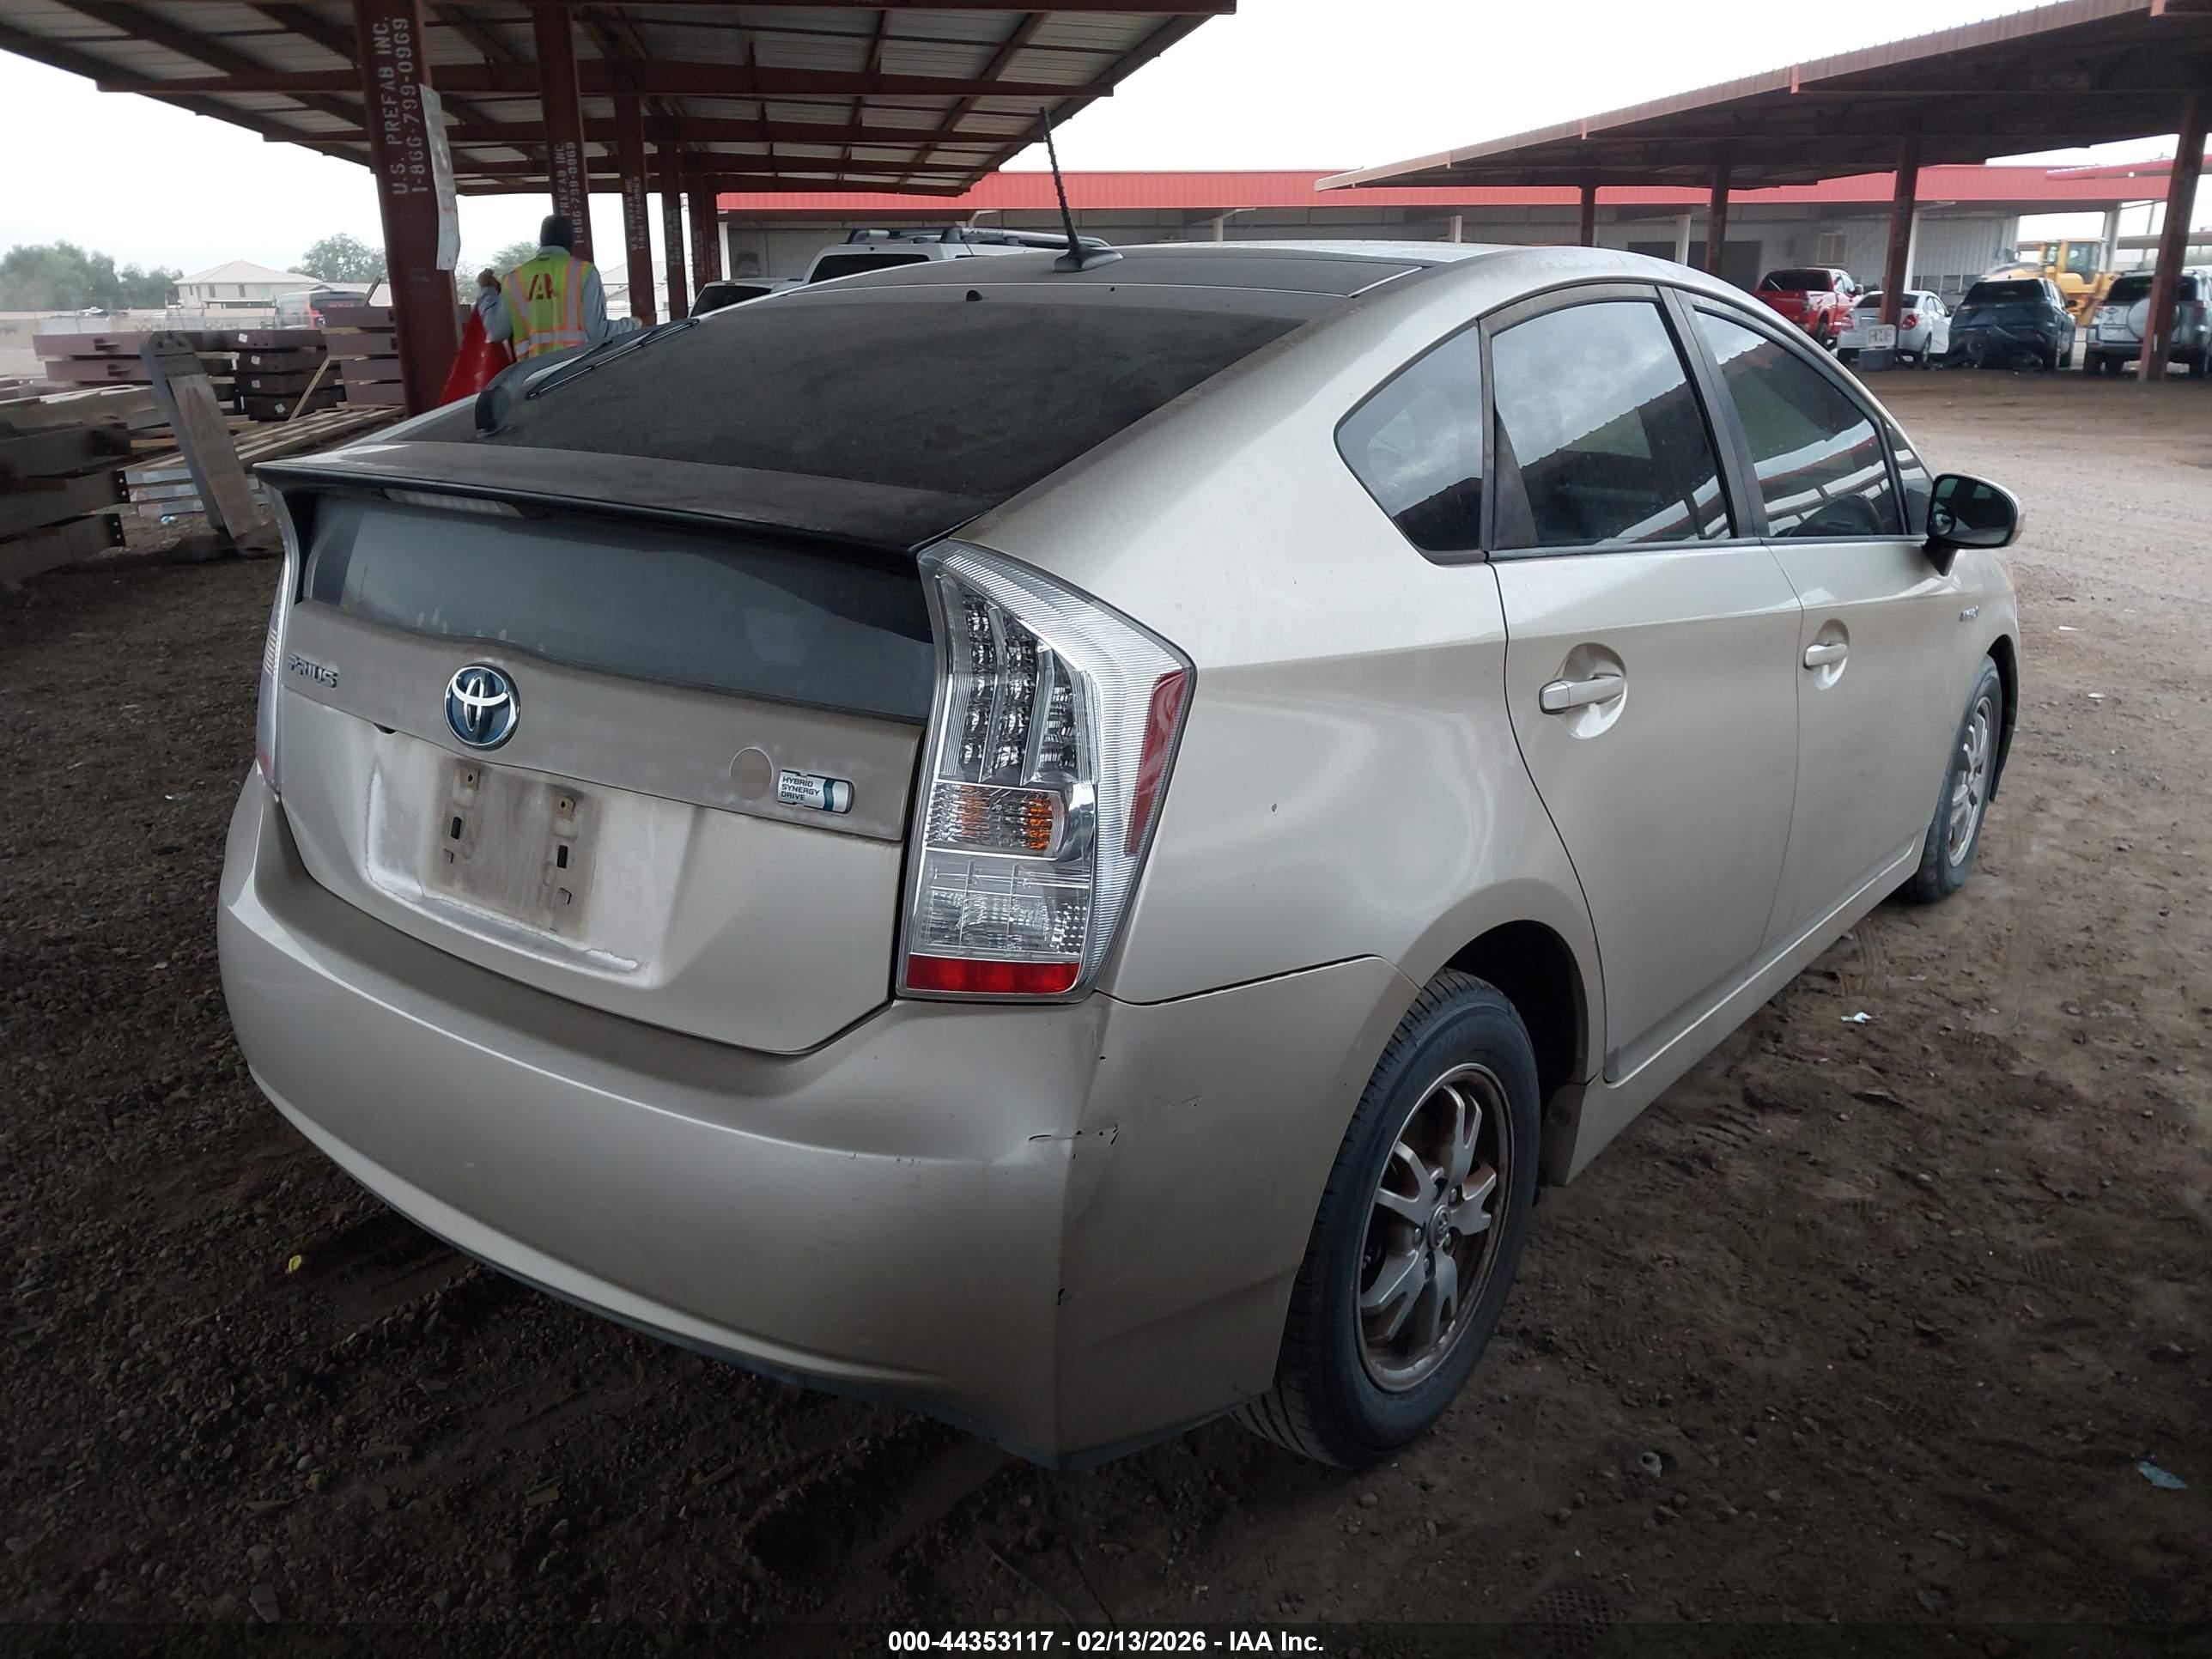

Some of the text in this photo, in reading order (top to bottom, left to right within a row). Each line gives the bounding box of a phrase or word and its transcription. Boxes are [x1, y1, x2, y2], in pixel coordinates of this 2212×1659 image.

[373, 16, 408, 194] U.S. PREFAB INC.
[392, 18, 428, 191] 1-866-799-0969
[289, 653, 338, 688] PRIUS
[781, 784, 820, 796] SYNERGY
[782, 775, 813, 787] HYBRID
[781, 791, 805, 800] DRIVE
